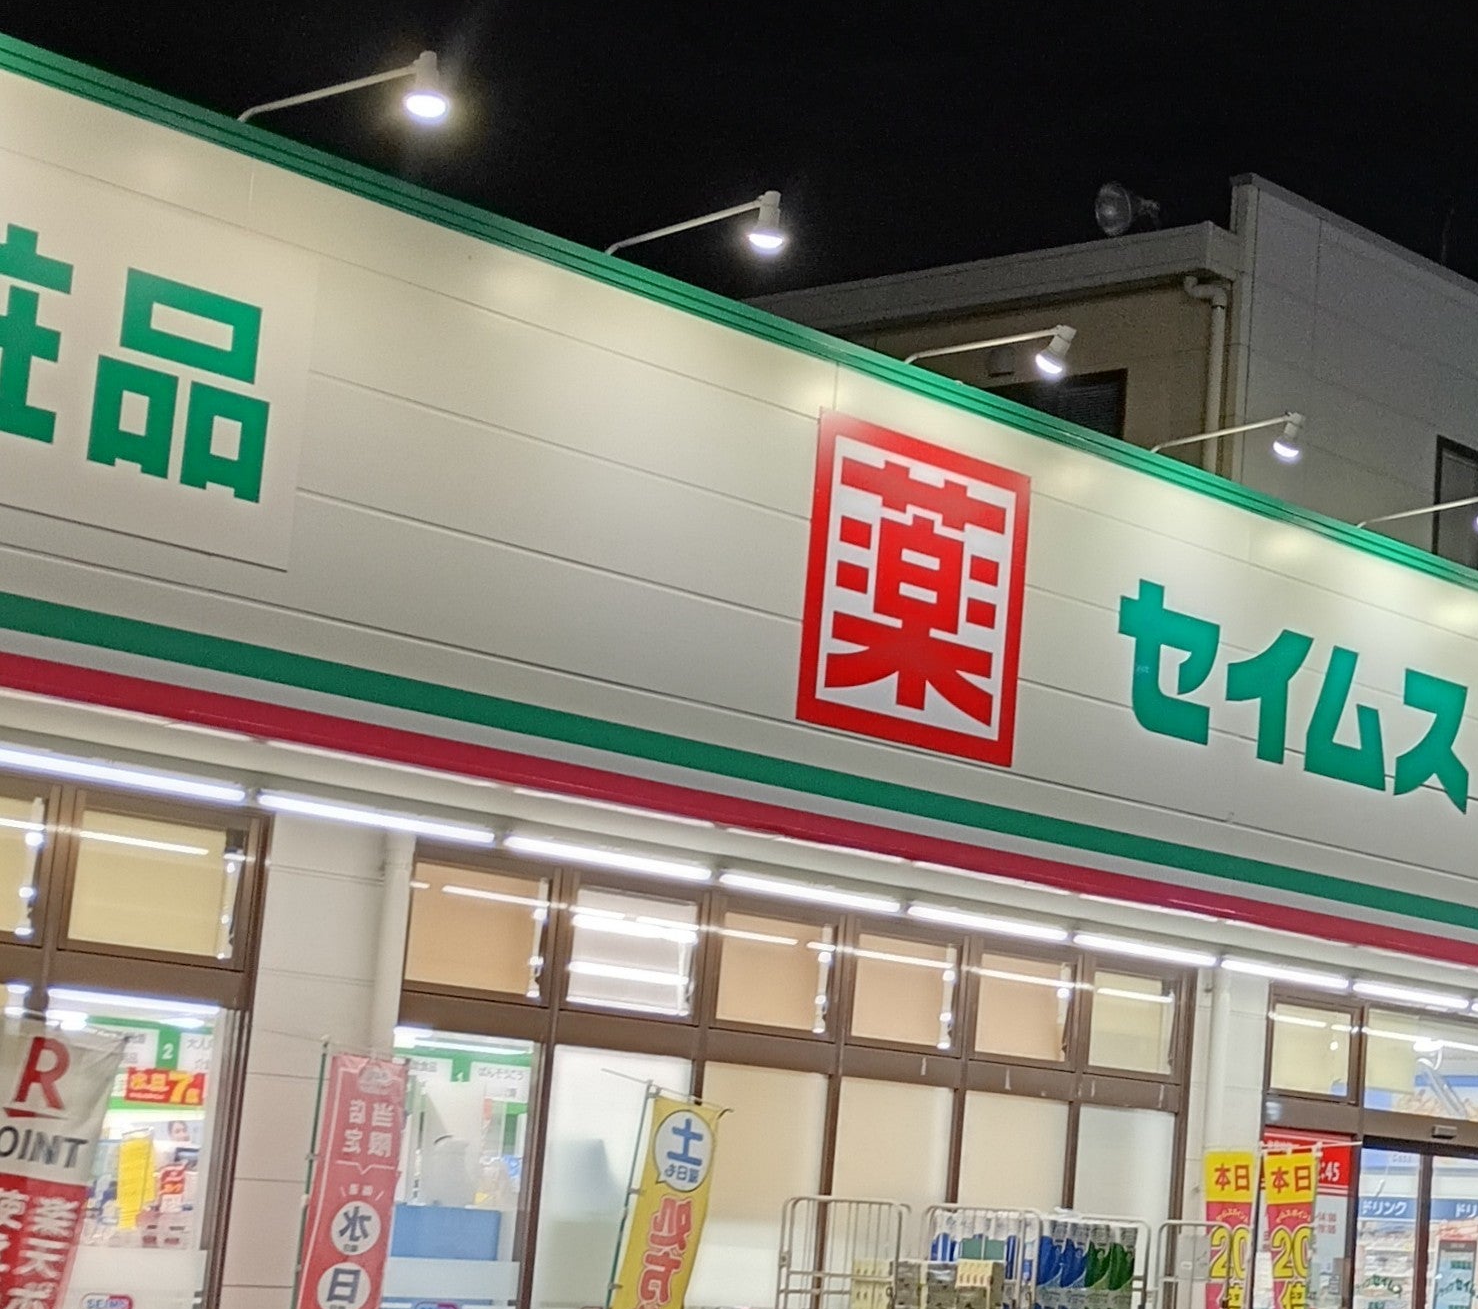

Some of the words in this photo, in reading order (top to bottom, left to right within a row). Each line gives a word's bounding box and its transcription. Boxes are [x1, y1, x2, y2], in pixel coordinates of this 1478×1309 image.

[824, 454, 1007, 727] 薬
[1117, 578, 1470, 814] セイムス
[162, 1043, 174, 1060] 2
[14, 1036, 70, 1110] R
[1214, 1163, 1250, 1192] 本日
[1270, 1165, 1312, 1193] 本日
[1362, 1200, 1408, 1216] ドリンク
[1272, 1226, 1312, 1279] 20
